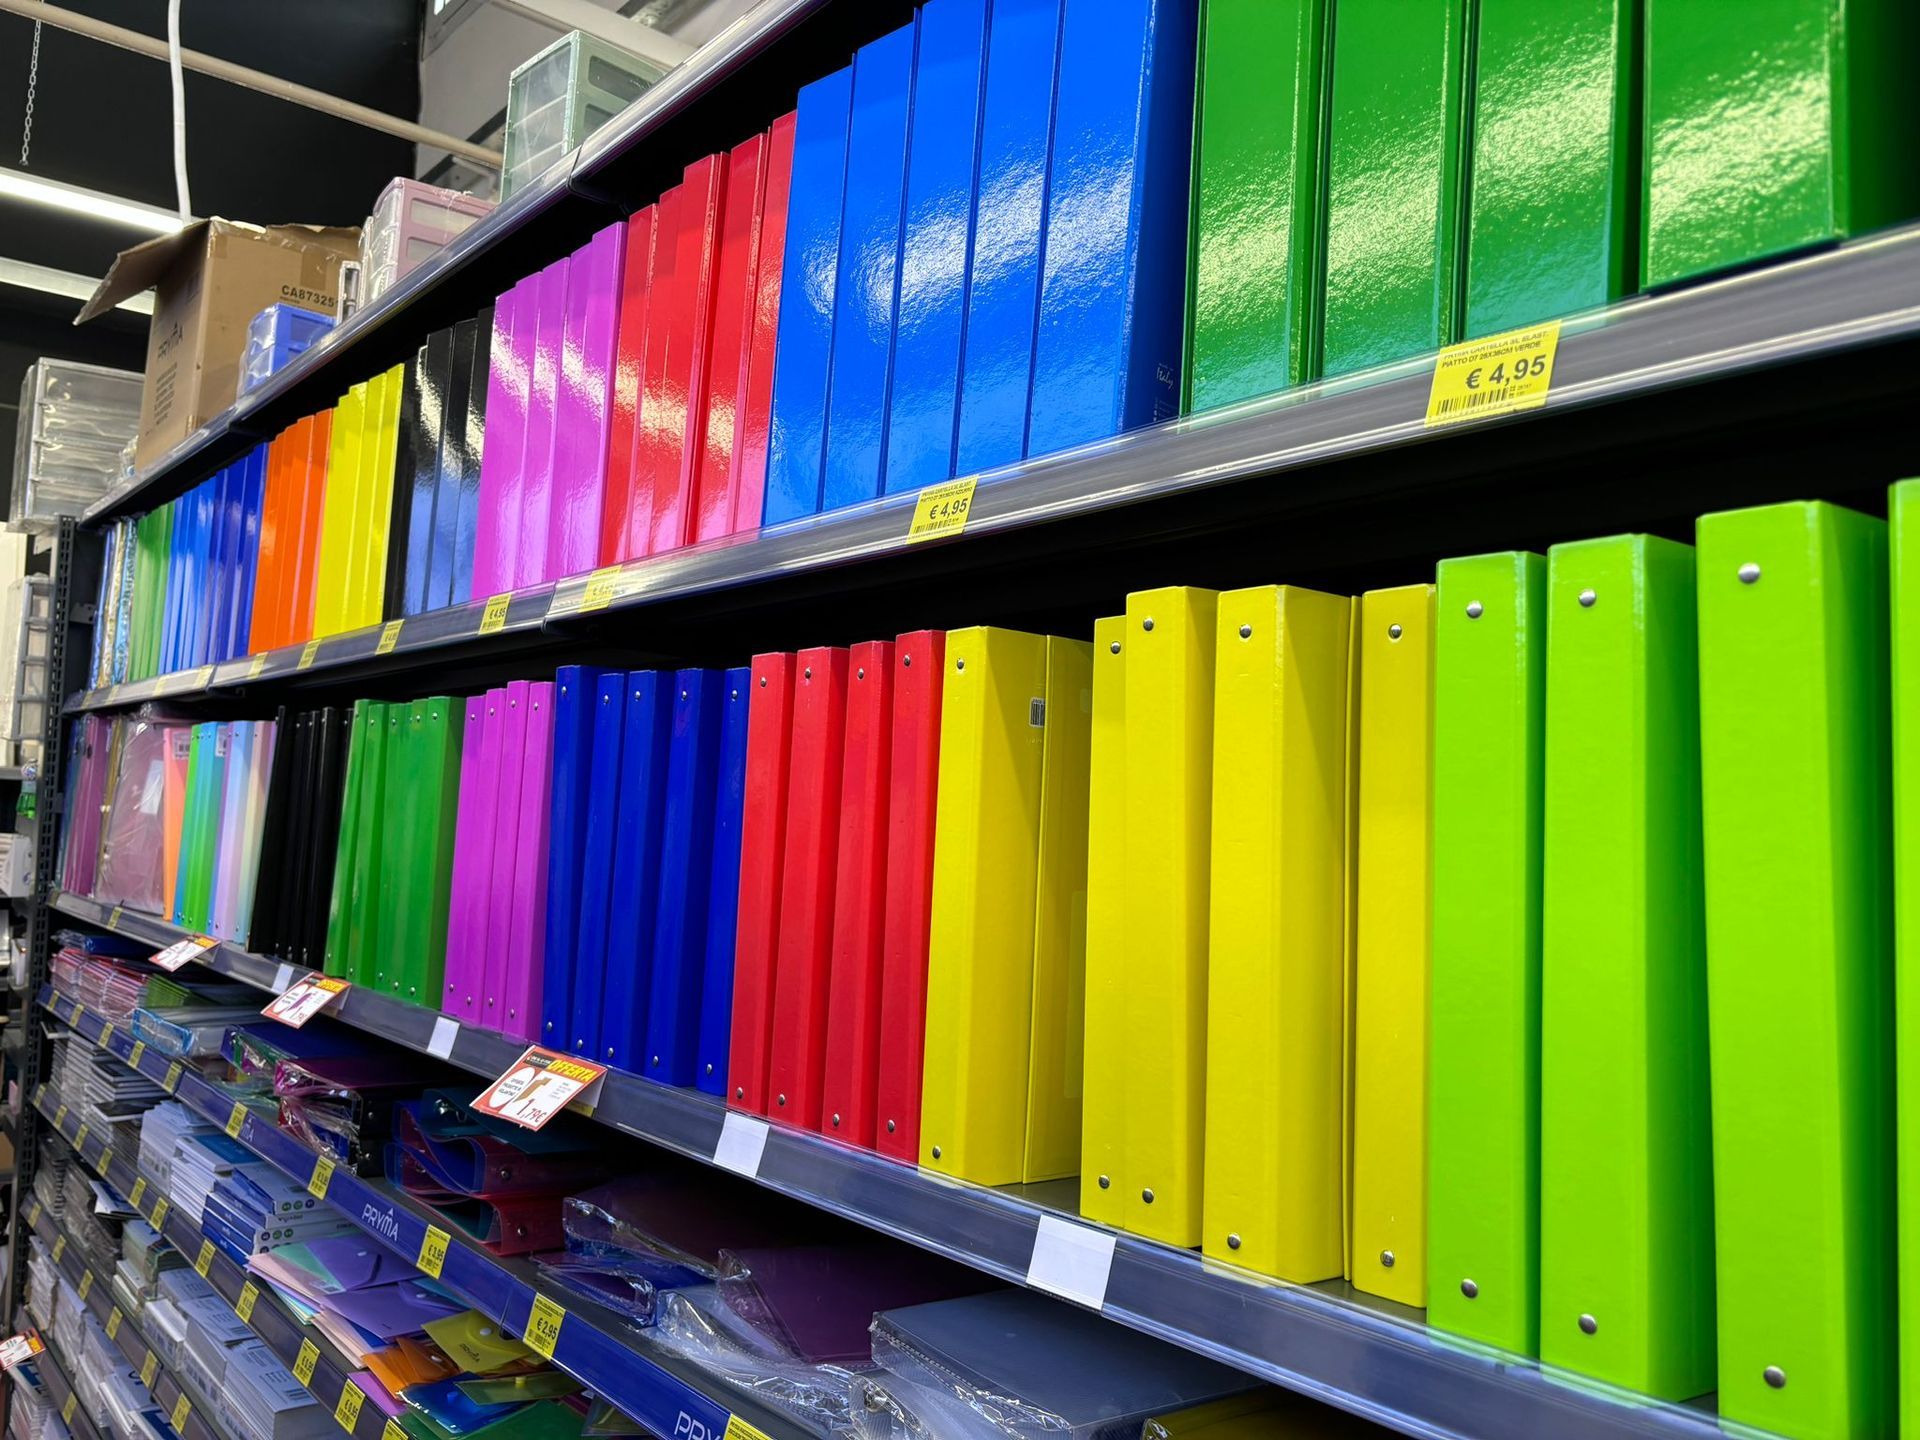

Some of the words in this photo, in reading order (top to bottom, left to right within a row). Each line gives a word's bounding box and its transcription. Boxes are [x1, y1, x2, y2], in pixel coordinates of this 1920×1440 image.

[281, 284, 335, 308] CA87325
[1441, 356, 1468, 369] PIATTO
[1466, 367, 1482, 390] €
[1489, 354, 1547, 387] 4,95
[930, 504, 939, 519] €
[940, 498, 968, 519] 4,95
[546, 1059, 598, 1083] OFFERTA
[361, 1203, 399, 1241] PRYMA
[536, 1316, 543, 1331] €
[542, 1320, 558, 1340] 2,95
